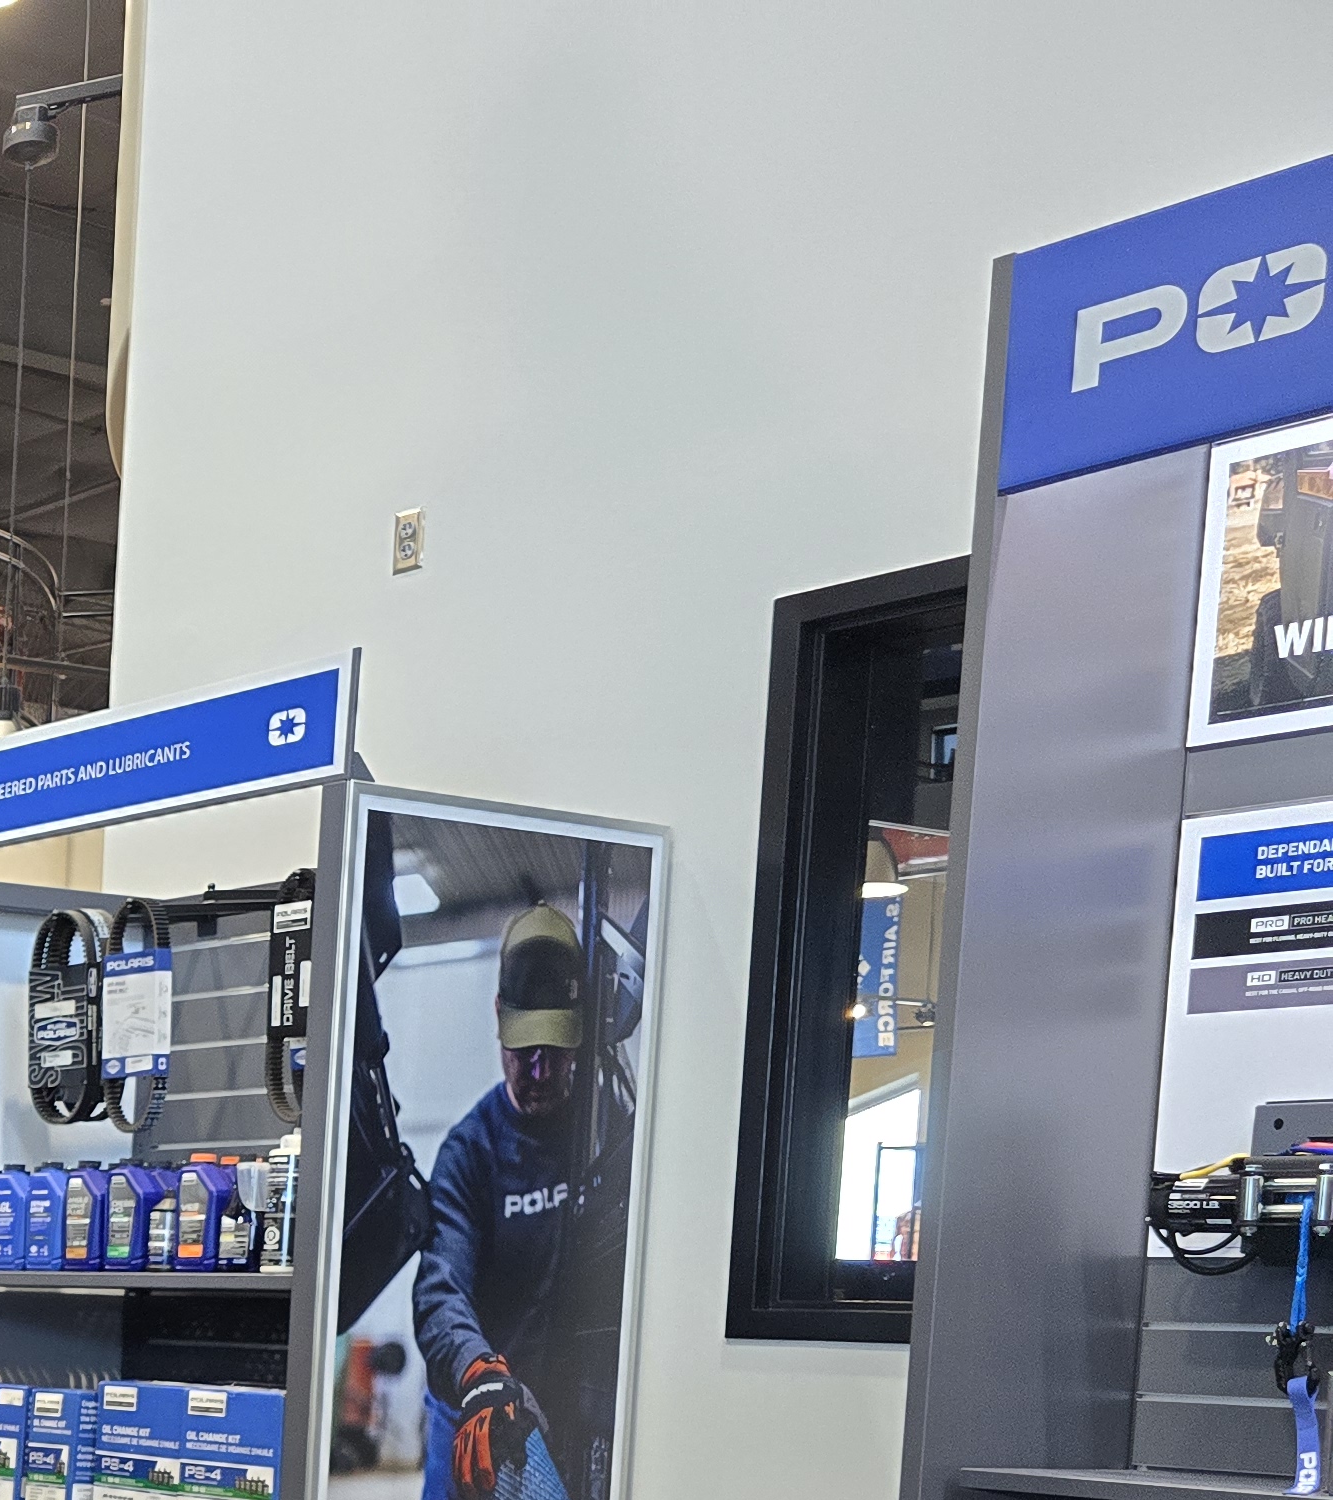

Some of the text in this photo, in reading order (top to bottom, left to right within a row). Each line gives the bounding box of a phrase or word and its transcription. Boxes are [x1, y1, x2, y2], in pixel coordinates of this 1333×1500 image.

[37, 768, 75, 791] PARTS
[77, 761, 107, 782] AND
[108, 741, 191, 775] LUBRICANTS
[1255, 857, 1333, 879] BUILT FOR
[1255, 918, 1285, 930] PRO
[1293, 916, 1313, 926] PRO
[106, 955, 155, 973] POLARIS
[283, 936, 296, 1026] DRIVE BELT
[1250, 973, 1272, 983] HD
[1281, 970, 1312, 981] HEAVY
[28, 970, 62, 1088] SNW
[37, 1028, 77, 1039] POLARIS
[102, 1424, 151, 1437] OIL CHANGE KIT
[186, 1430, 241, 1444] OIL CHANGE KIT
[28, 1451, 56, 1465] PS-4
[101, 1457, 134, 1472] PS-4
[185, 1465, 222, 1481] PS-4
